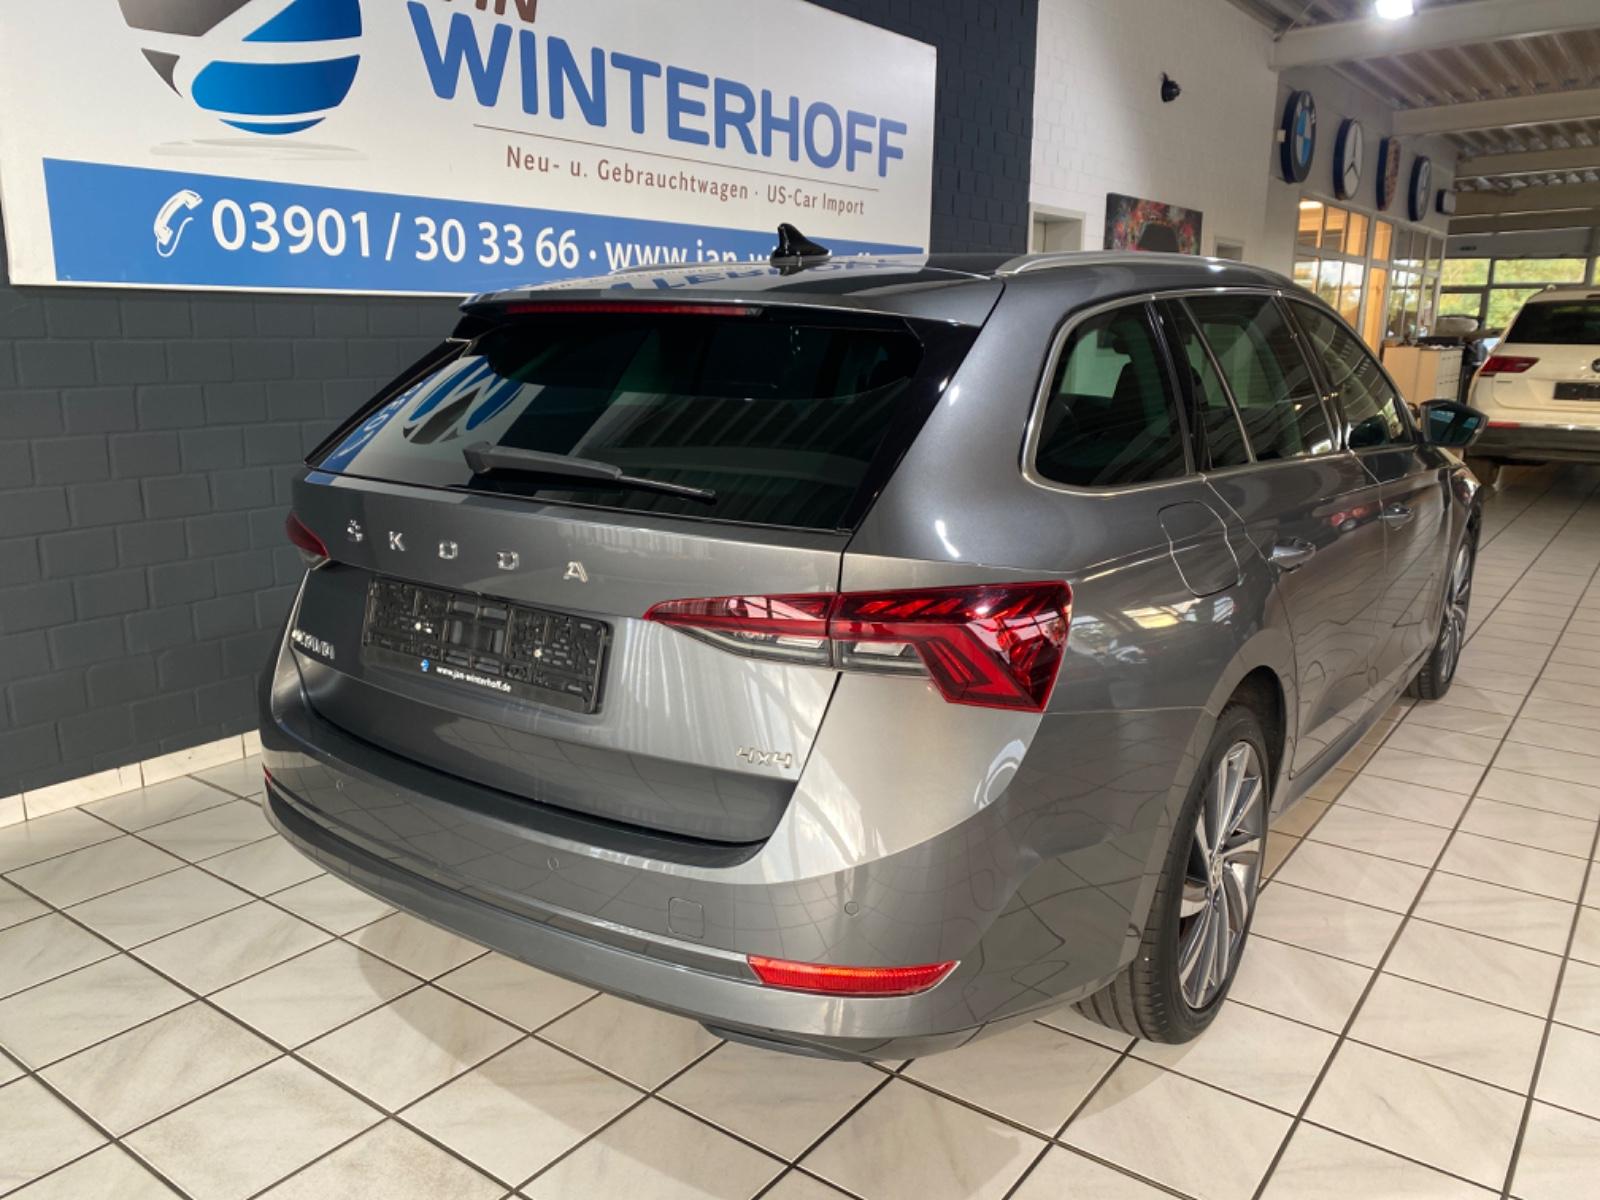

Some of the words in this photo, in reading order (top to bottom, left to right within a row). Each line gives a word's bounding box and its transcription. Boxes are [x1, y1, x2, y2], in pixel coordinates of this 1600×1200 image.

[407, 1, 907, 178] WINTERHOFF
[506, 145, 560, 172] Neu-
[570, 158, 587, 178] u.
[597, 158, 748, 201] Gebrauchtwagen
[766, 184, 817, 209] US-Car
[822, 192, 864, 216] Import
[212, 199, 370, 258] 03901
[414, 216, 466, 263] 30
[478, 221, 524, 266] 33
[535, 227, 580, 269] 66
